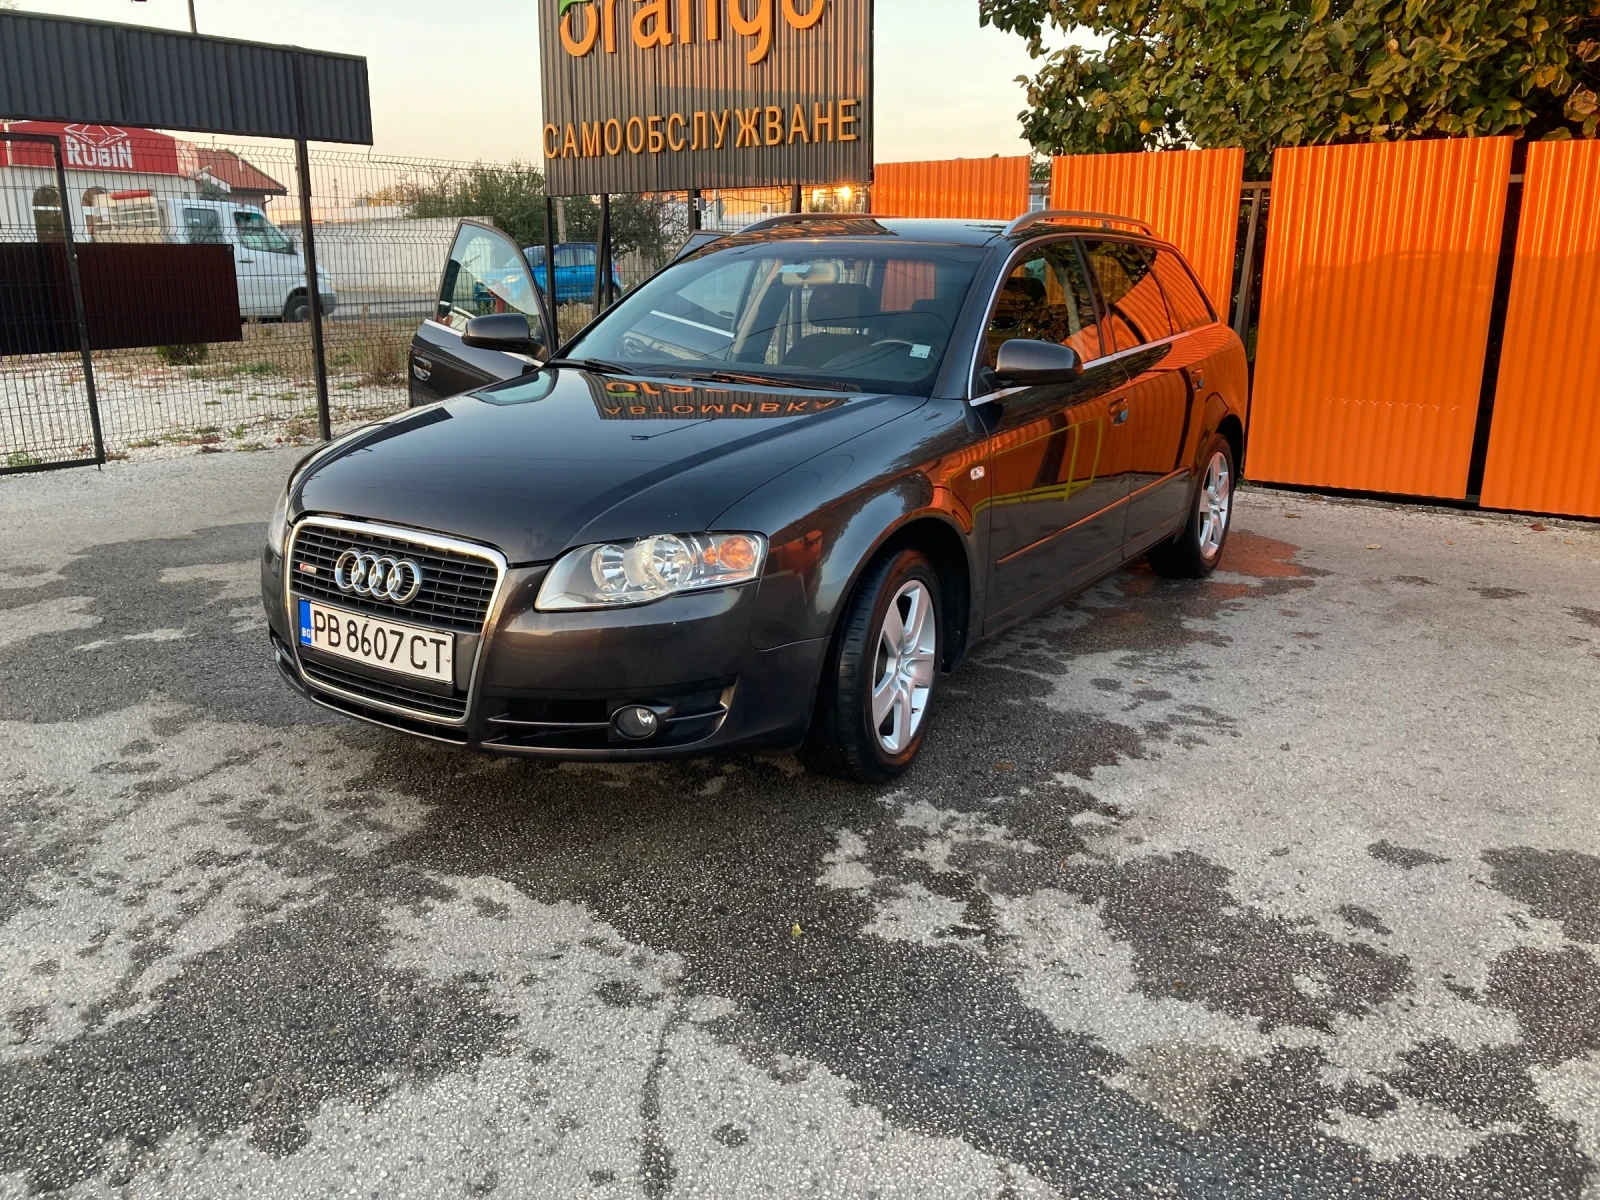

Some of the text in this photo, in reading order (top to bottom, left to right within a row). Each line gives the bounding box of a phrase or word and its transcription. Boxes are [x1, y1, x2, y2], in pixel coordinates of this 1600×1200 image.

[65, 135, 134, 169] RUBIN
[543, 99, 859, 159] САМООБСЛУЖВАНЕ
[301, 627, 311, 638] BG
[313, 610, 447, 674] PB 8607 CT
